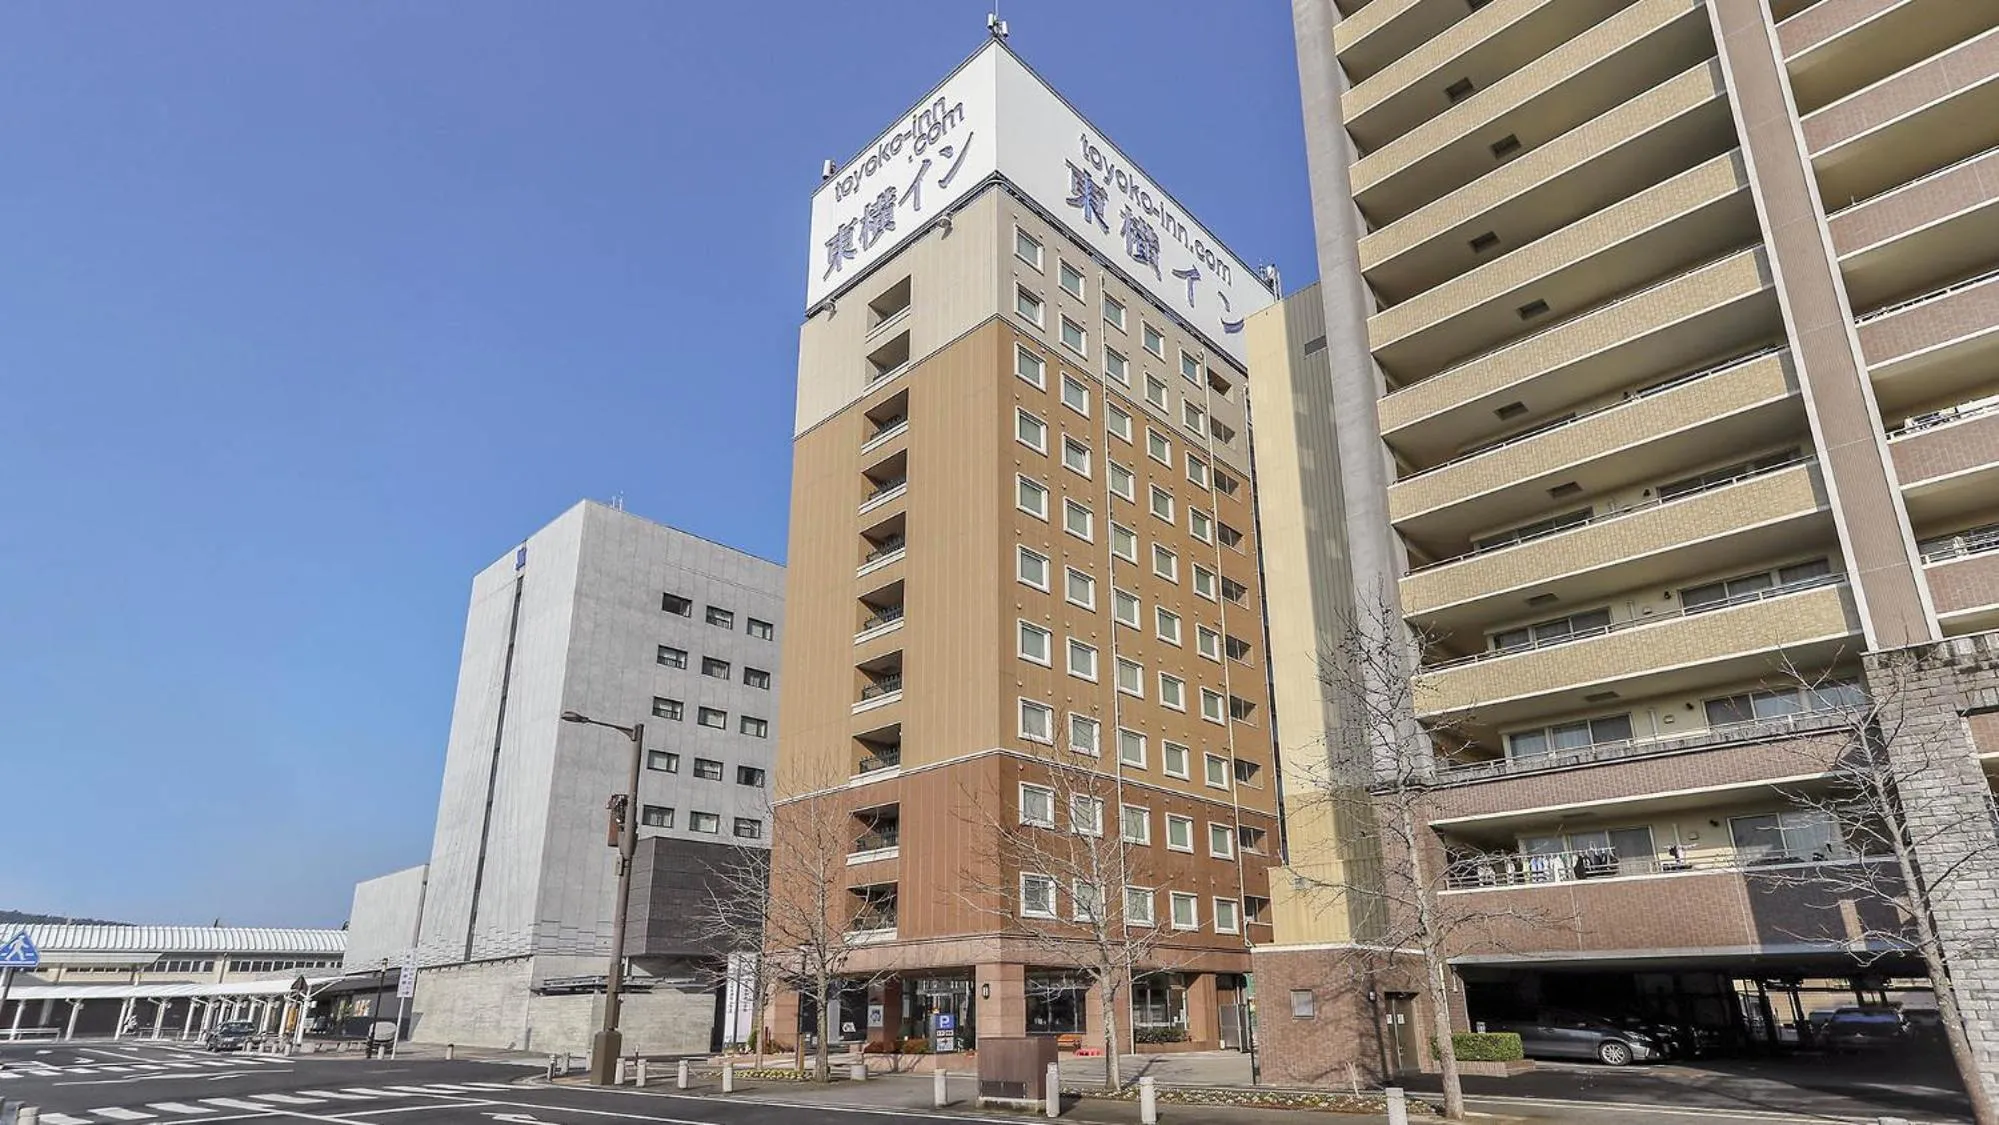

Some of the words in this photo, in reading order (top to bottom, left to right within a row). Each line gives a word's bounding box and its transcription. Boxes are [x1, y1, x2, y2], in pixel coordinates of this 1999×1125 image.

[834, 96, 947, 203] toyoko-inn
[907, 102, 964, 164] .com
[823, 131, 974, 282] 東横イン
[1065, 158, 1246, 334] 東横イン
[1080, 133, 1232, 287] toyoko-inn.com
[940, 1015, 950, 1028] P
